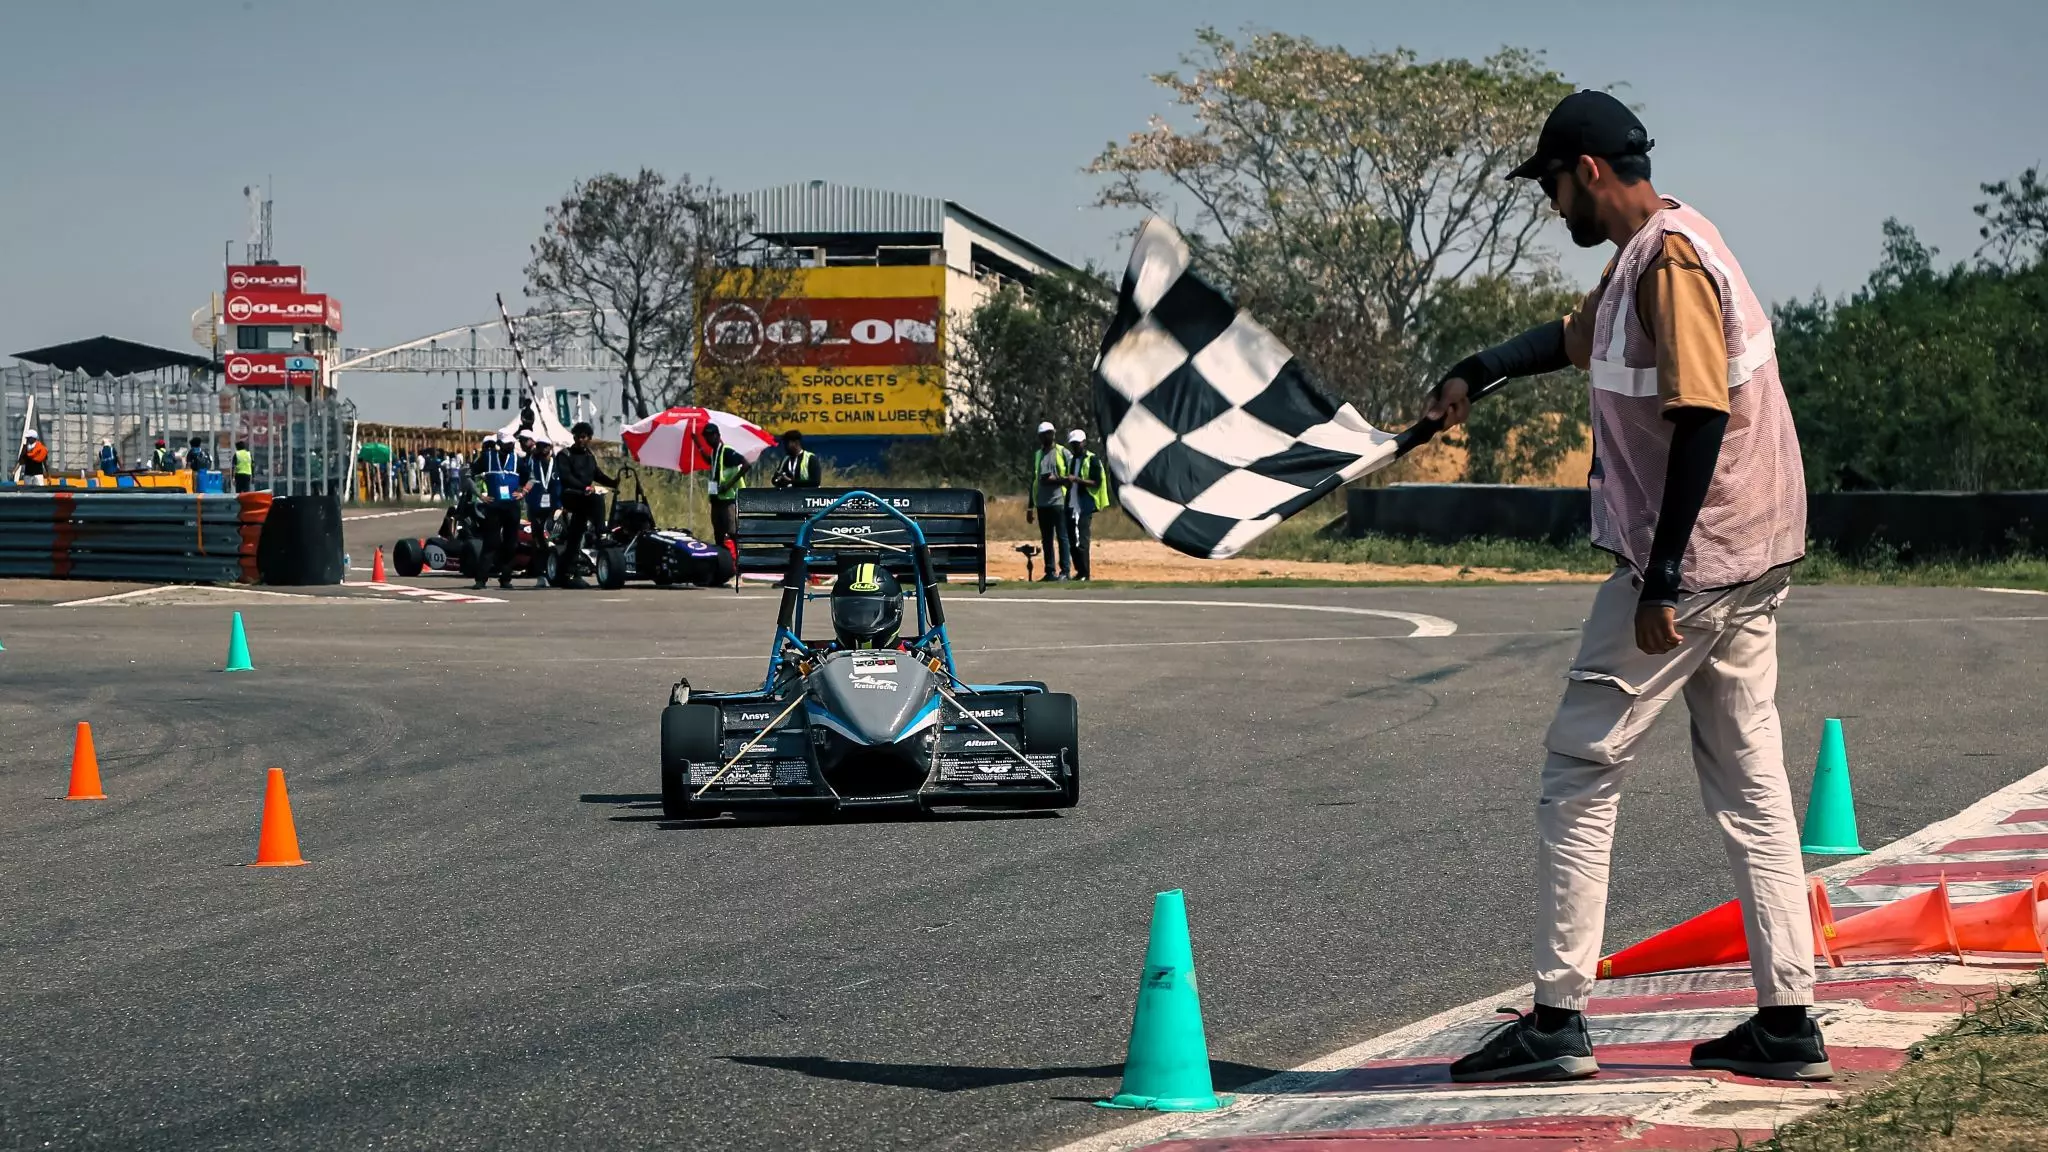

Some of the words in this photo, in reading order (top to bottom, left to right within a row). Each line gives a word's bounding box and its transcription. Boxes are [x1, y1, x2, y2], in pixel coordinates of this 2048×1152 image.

[231, 272, 298, 289] ROLON
[228, 296, 323, 321] ROLON
[802, 374, 898, 387] SPROCKETS
[832, 393, 885, 405] BELTS
[835, 410, 875, 422] CHAIN
[879, 409, 928, 422] LUBES
[894, 498, 910, 507] 5.0
